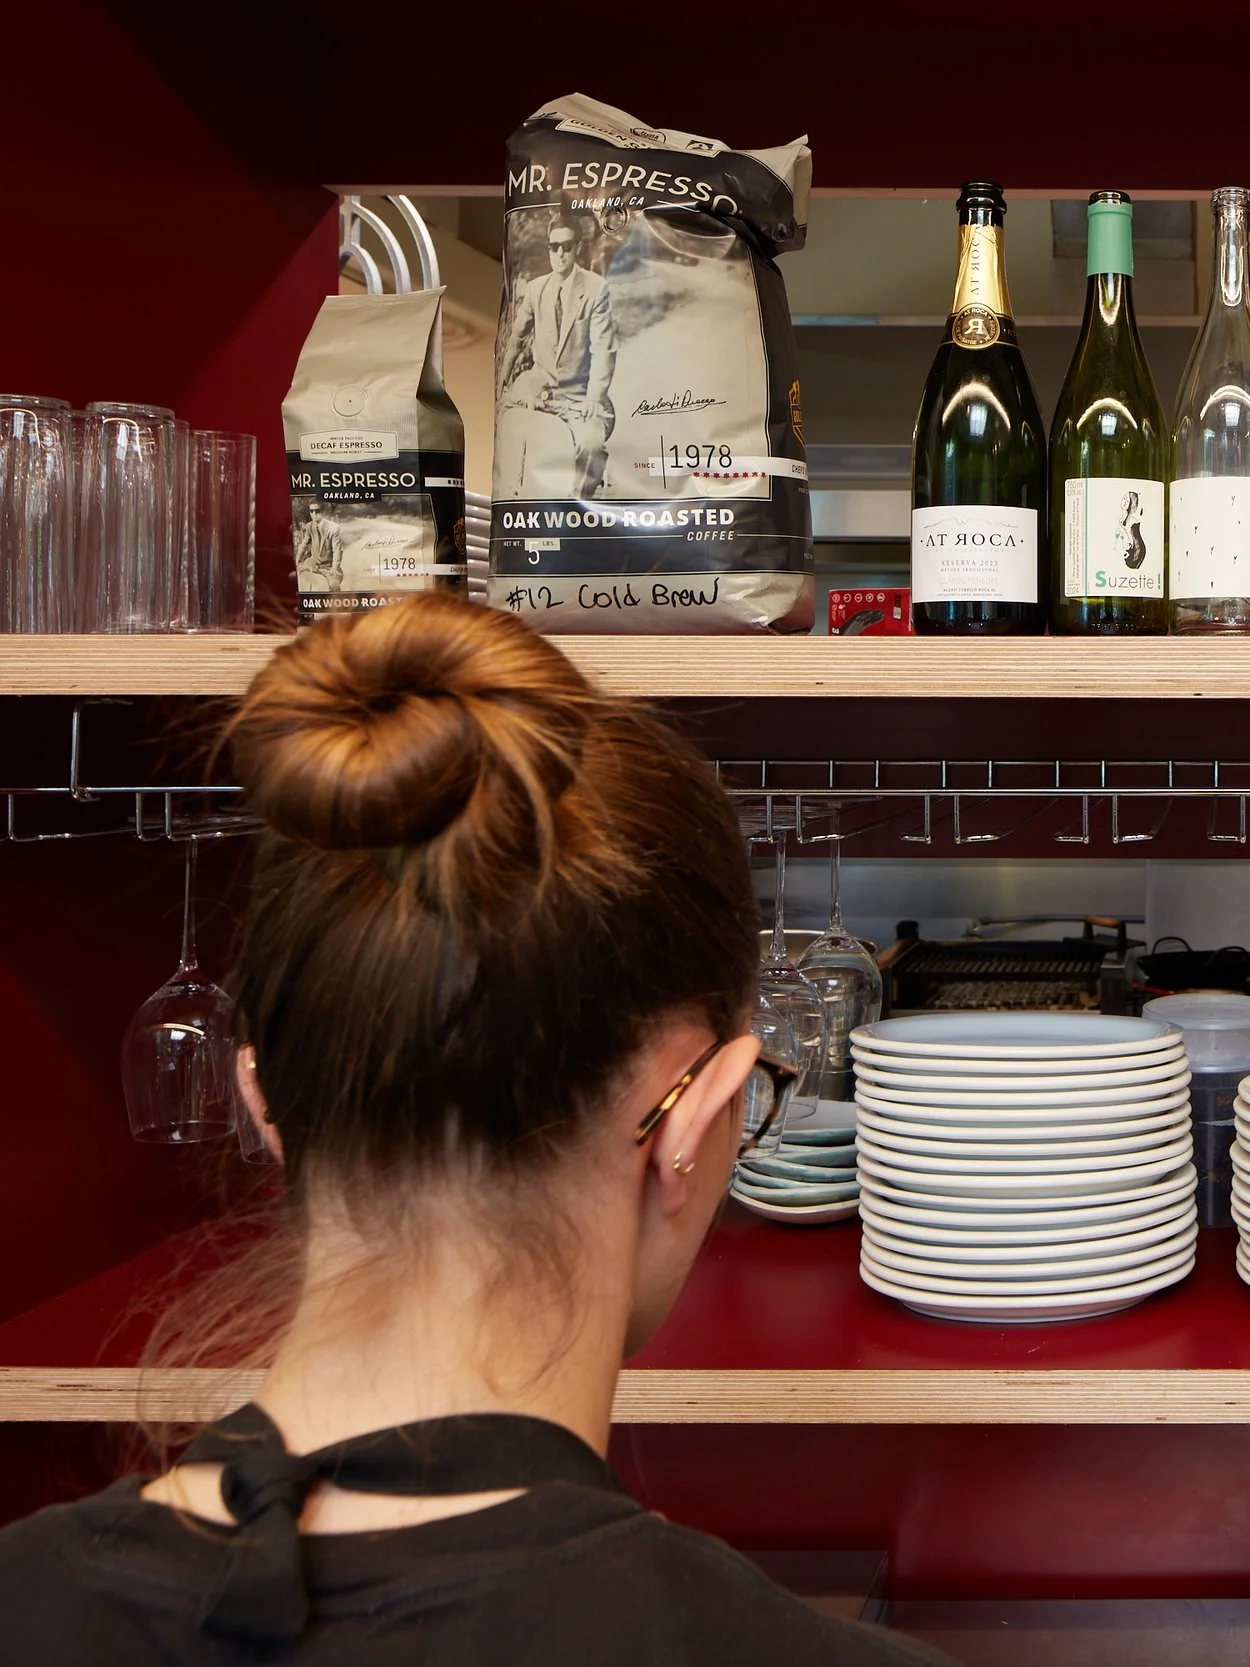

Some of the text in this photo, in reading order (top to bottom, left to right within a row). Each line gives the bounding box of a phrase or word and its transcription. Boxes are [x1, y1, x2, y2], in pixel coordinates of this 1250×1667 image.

[508, 164, 552, 197] MR.
[571, 196, 645, 210] OAKLAND, CA
[310, 440, 383, 450] DECAF ESPRESSO
[669, 444, 733, 469] 1978
[291, 472, 416, 489] MR. ESPRESSO
[323, 492, 362, 500] OAKLAND,
[503, 508, 735, 529] OAK WOOD ROASTED
[686, 530, 735, 542] COFFEE
[528, 541, 540, 565] 5
[383, 557, 416, 571] 1978
[505, 577, 720, 612] #12 Cold Brew
[303, 598, 322, 609] OAK
[322, 598, 359, 608] WOOD
